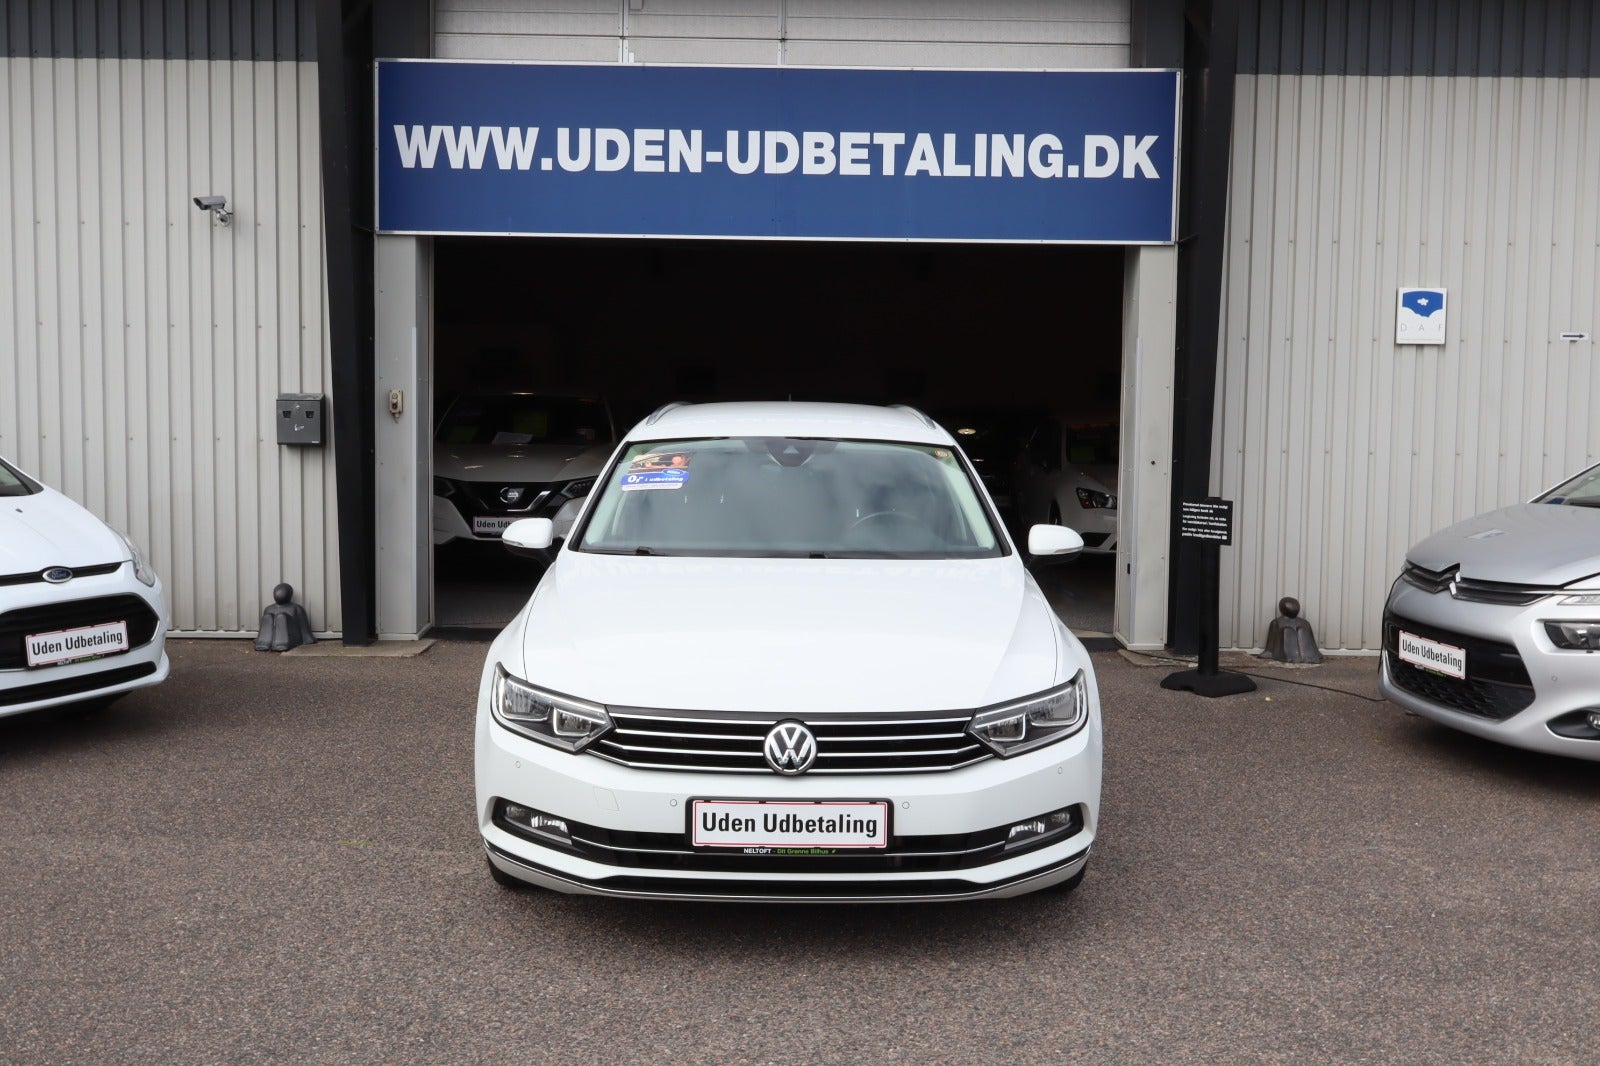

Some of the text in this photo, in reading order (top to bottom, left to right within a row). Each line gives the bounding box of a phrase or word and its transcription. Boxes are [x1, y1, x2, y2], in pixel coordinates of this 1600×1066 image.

[393, 124, 1160, 180] WWW.UDEN-UDBETALING.DK
[476, 520, 496, 528] Uden
[32, 631, 123, 656] Uden Udbetaling
[1402, 639, 1420, 655] Uden
[1421, 645, 1462, 671] Udbetaling
[702, 812, 877, 838] Uden Udbetaling
